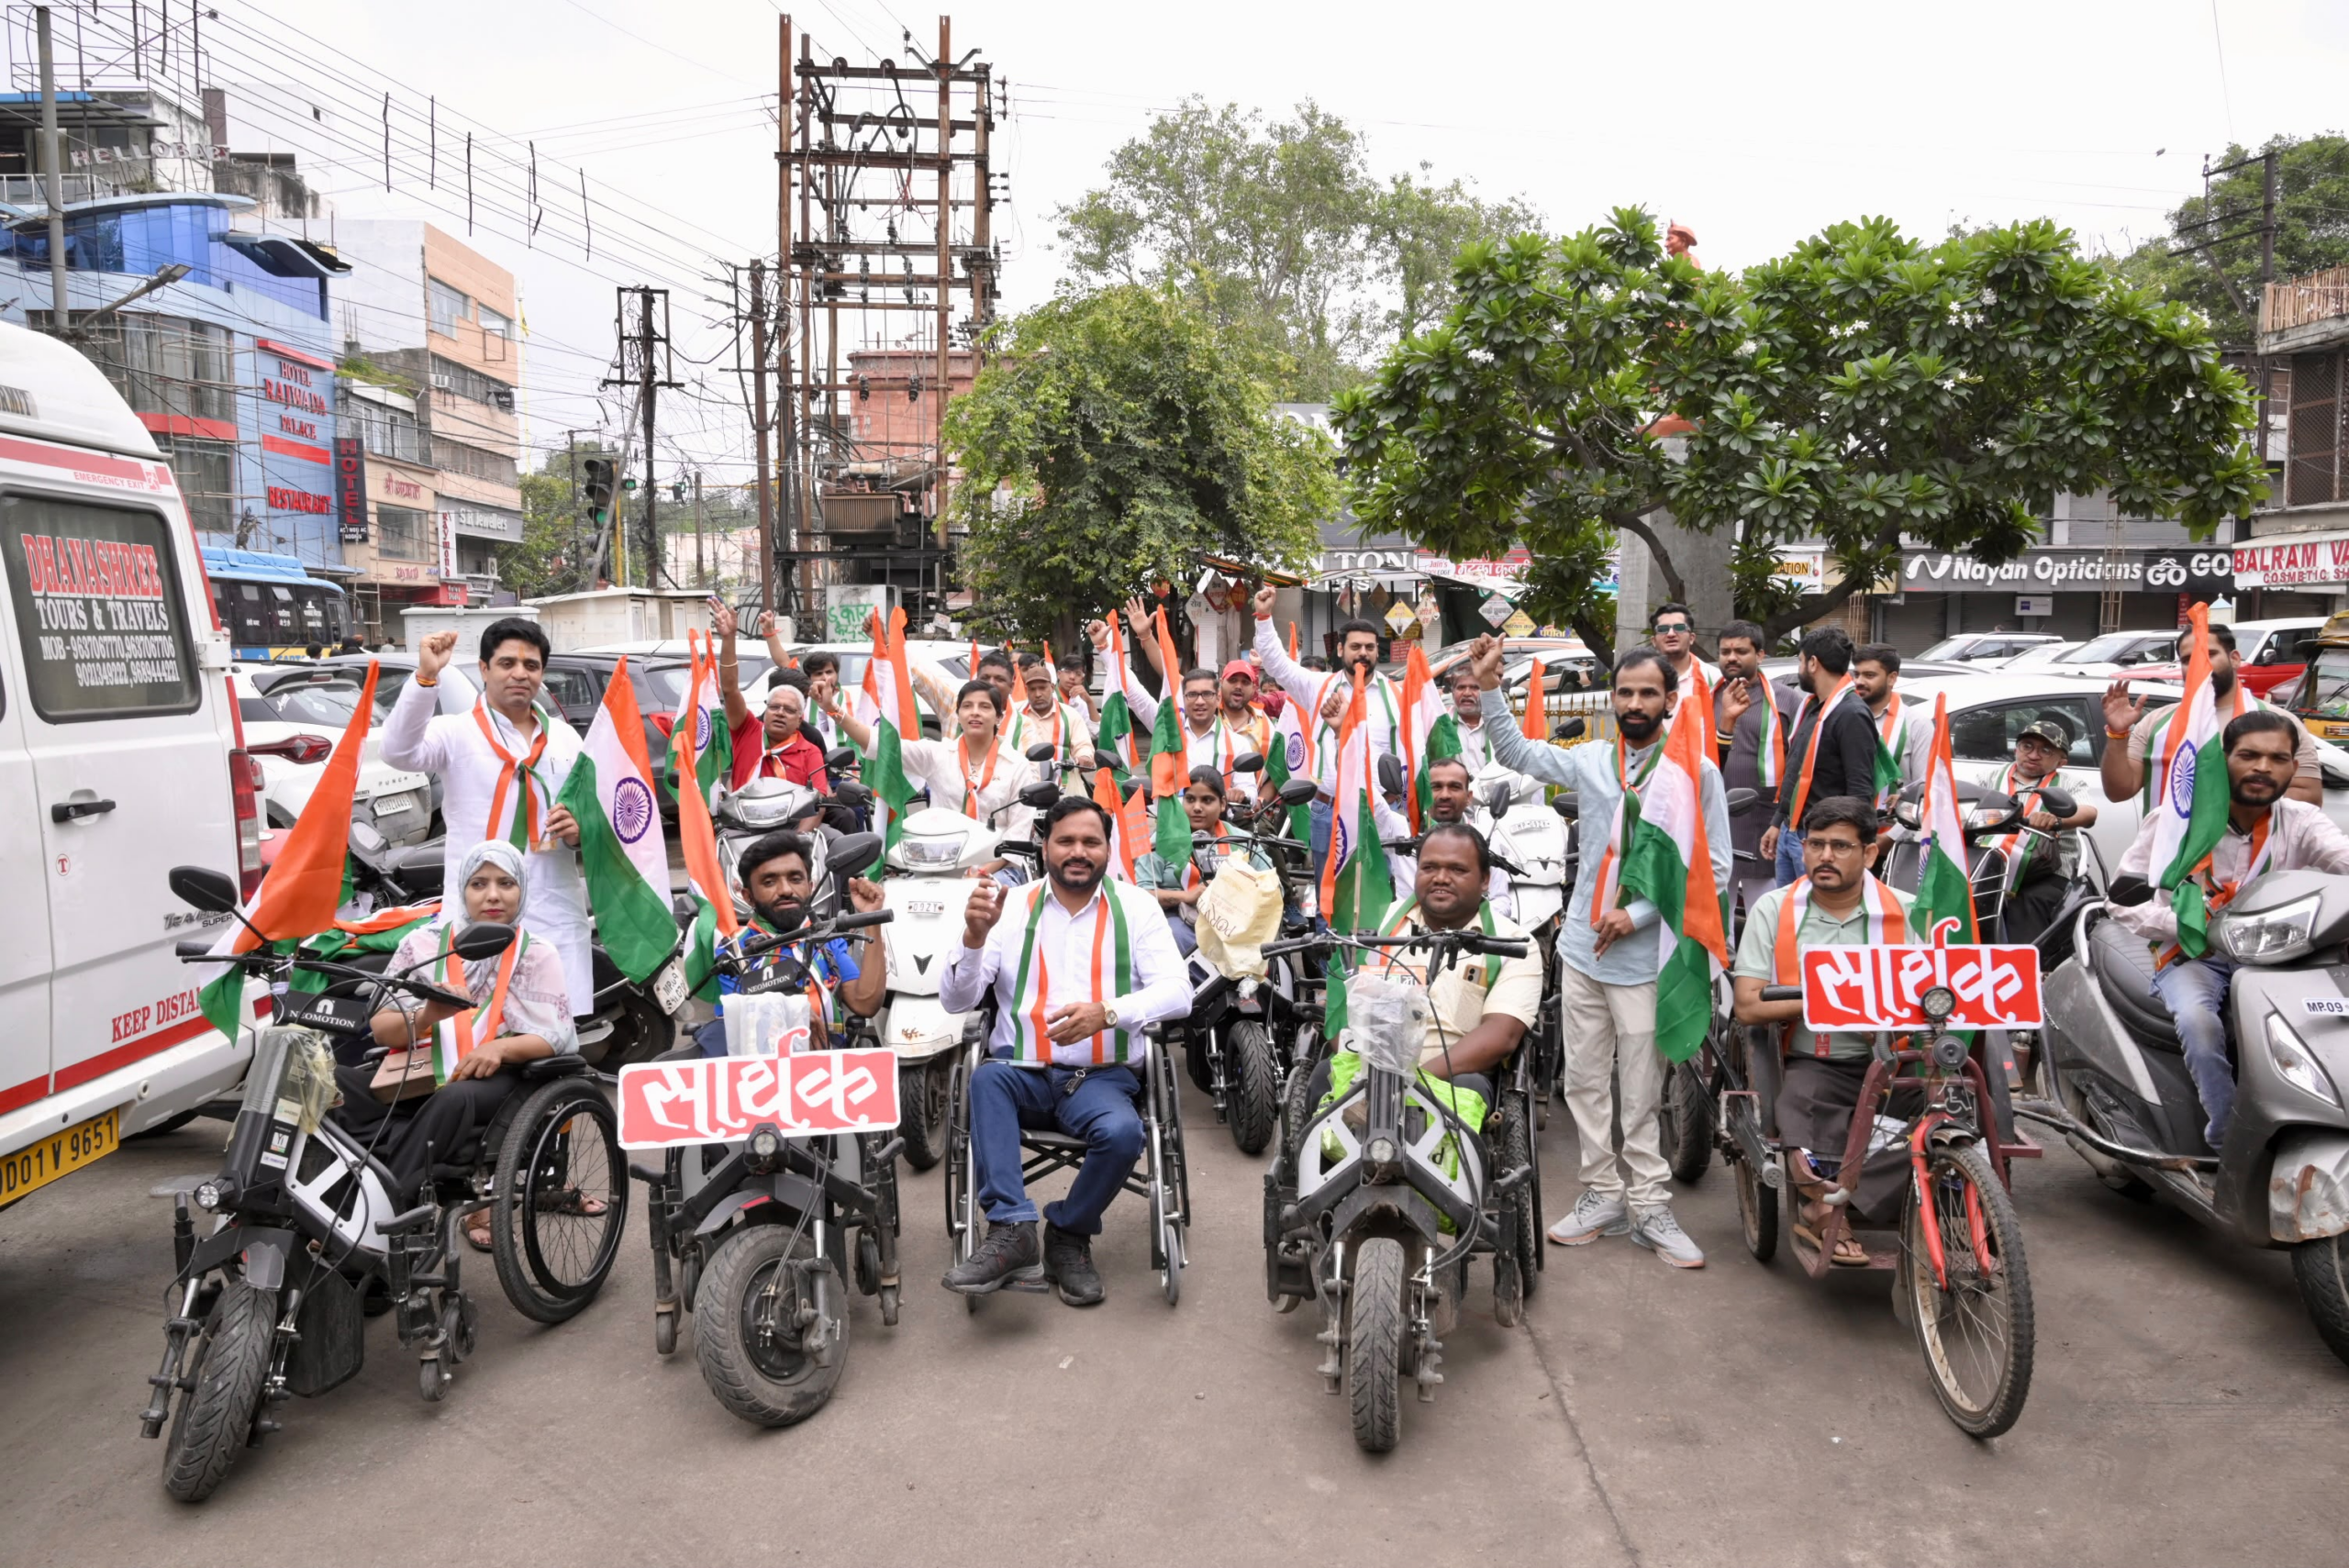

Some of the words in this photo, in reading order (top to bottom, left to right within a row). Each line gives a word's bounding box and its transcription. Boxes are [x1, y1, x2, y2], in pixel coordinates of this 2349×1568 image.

[279, 361, 312, 387] HOTEL
[264, 378, 328, 416] RAJWADA
[280, 415, 317, 439] PALACE
[73, 472, 125, 487] EMERGENCY
[128, 480, 145, 490] EXIT
[340, 439, 360, 524] HOTEL
[267, 485, 331, 515] RESTAURANT
[475, 512, 507, 531] Jewellers
[20, 533, 163, 601] DHANASHREE
[1429, 560, 1448, 568] Jain's
[1952, 557, 2029, 586] Nayan
[2033, 556, 2143, 586] Opticians
[2190, 552, 2234, 576] GO
[2233, 542, 2318, 573] BALRAM
[2263, 569, 2328, 584] COSMETIC
[35, 598, 88, 631] TOURS
[93, 599, 106, 630] &
[106, 601, 169, 631] TRAVELS
[57, 857, 68, 873] T
[202, 914, 233, 928] SUPER
[747, 974, 791, 995] NEOMOTION
[1815, 917, 2024, 1029] सार्थक
[111, 1005, 150, 1044] KEEP
[289, 1010, 355, 1029] NEOMOTION
[640, 1027, 878, 1139] सार्थक
[0, 1147, 43, 1195] D01
[51, 1140, 62, 1170] V
[71, 1116, 114, 1162] 9651
